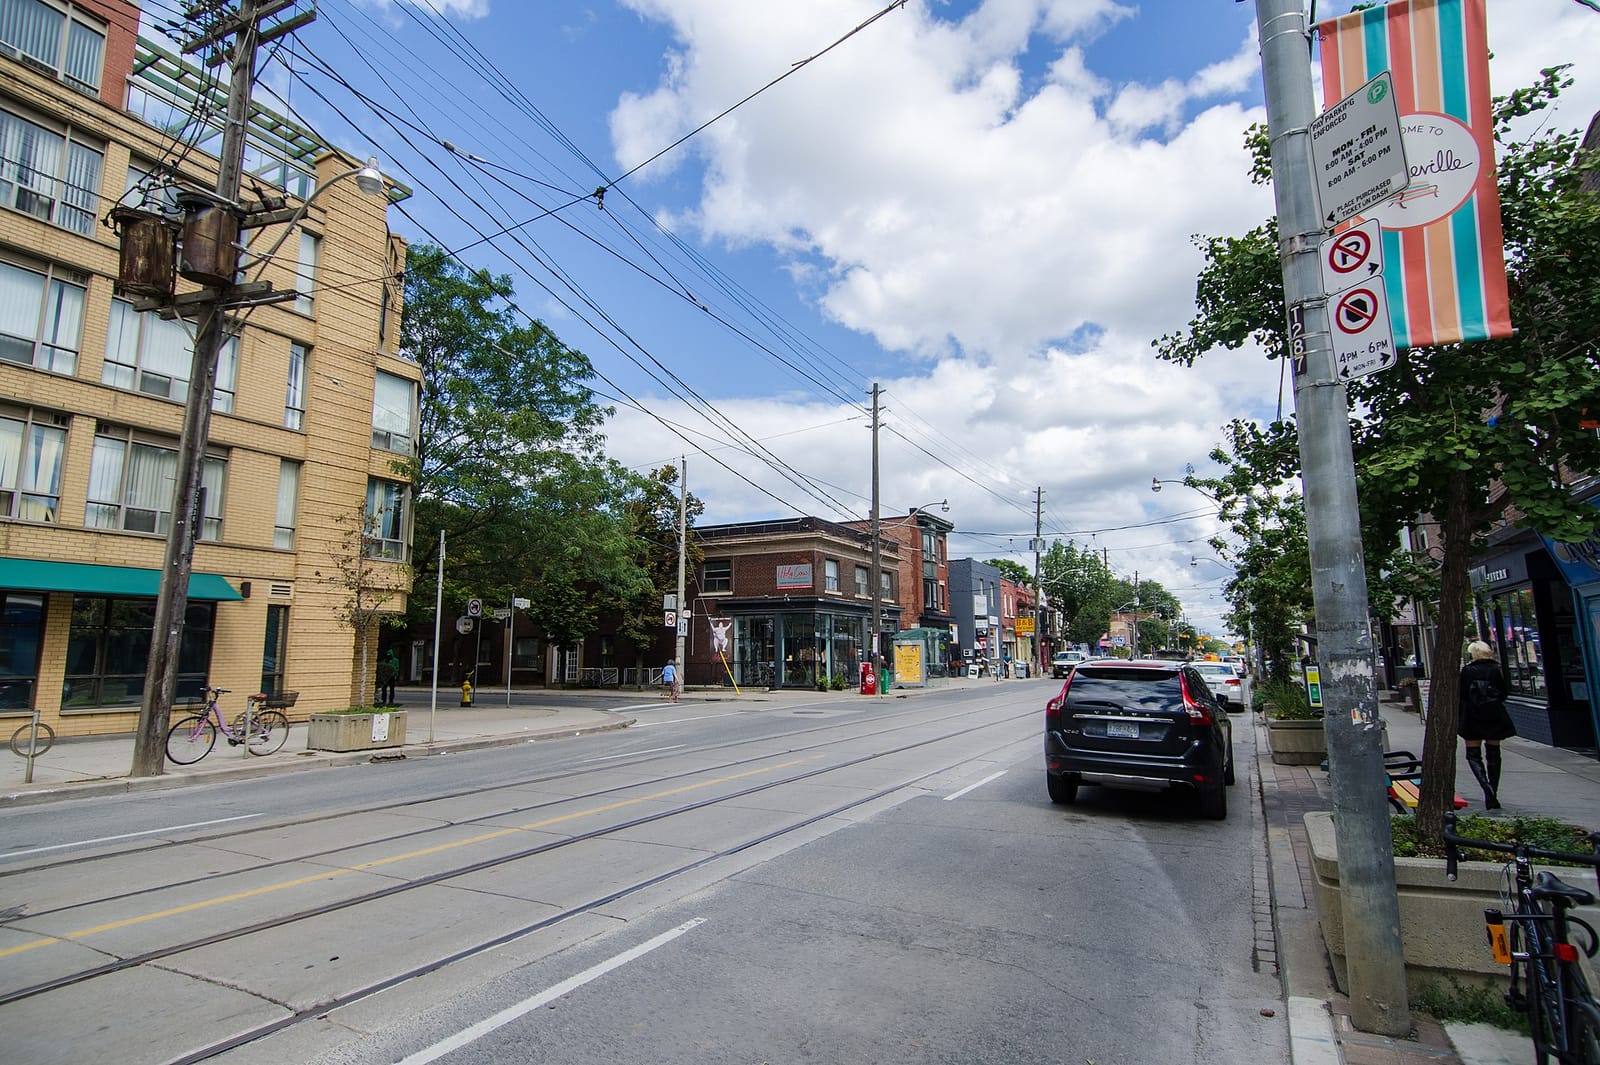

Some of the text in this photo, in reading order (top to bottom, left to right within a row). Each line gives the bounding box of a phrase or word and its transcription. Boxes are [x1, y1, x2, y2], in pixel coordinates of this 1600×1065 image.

[1312, 115, 1325, 131] PAY
[1313, 113, 1347, 140] ENFORCED
[1429, 125, 1444, 136] TO
[1325, 158, 1339, 171] 8:00
[1340, 150, 1353, 162] AM
[1358, 136, 1374, 149] 4:00
[1375, 127, 1388, 141] PM
[1332, 138, 1354, 157] MON
[1360, 124, 1377, 139] FRI
[1327, 175, 1342, 188] 8:00
[1343, 166, 1356, 179] AM
[1361, 153, 1377, 168] 6:00
[1378, 145, 1391, 158] PM
[1347, 150, 1366, 167] SAT
[1336, 178, 1391, 213] PLACE PURCHASED
[1341, 200, 1361, 217] TICKET
[1372, 187, 1389, 201] DASH
[1339, 352, 1358, 364] 4PM
[1368, 339, 1389, 354] 6PM
